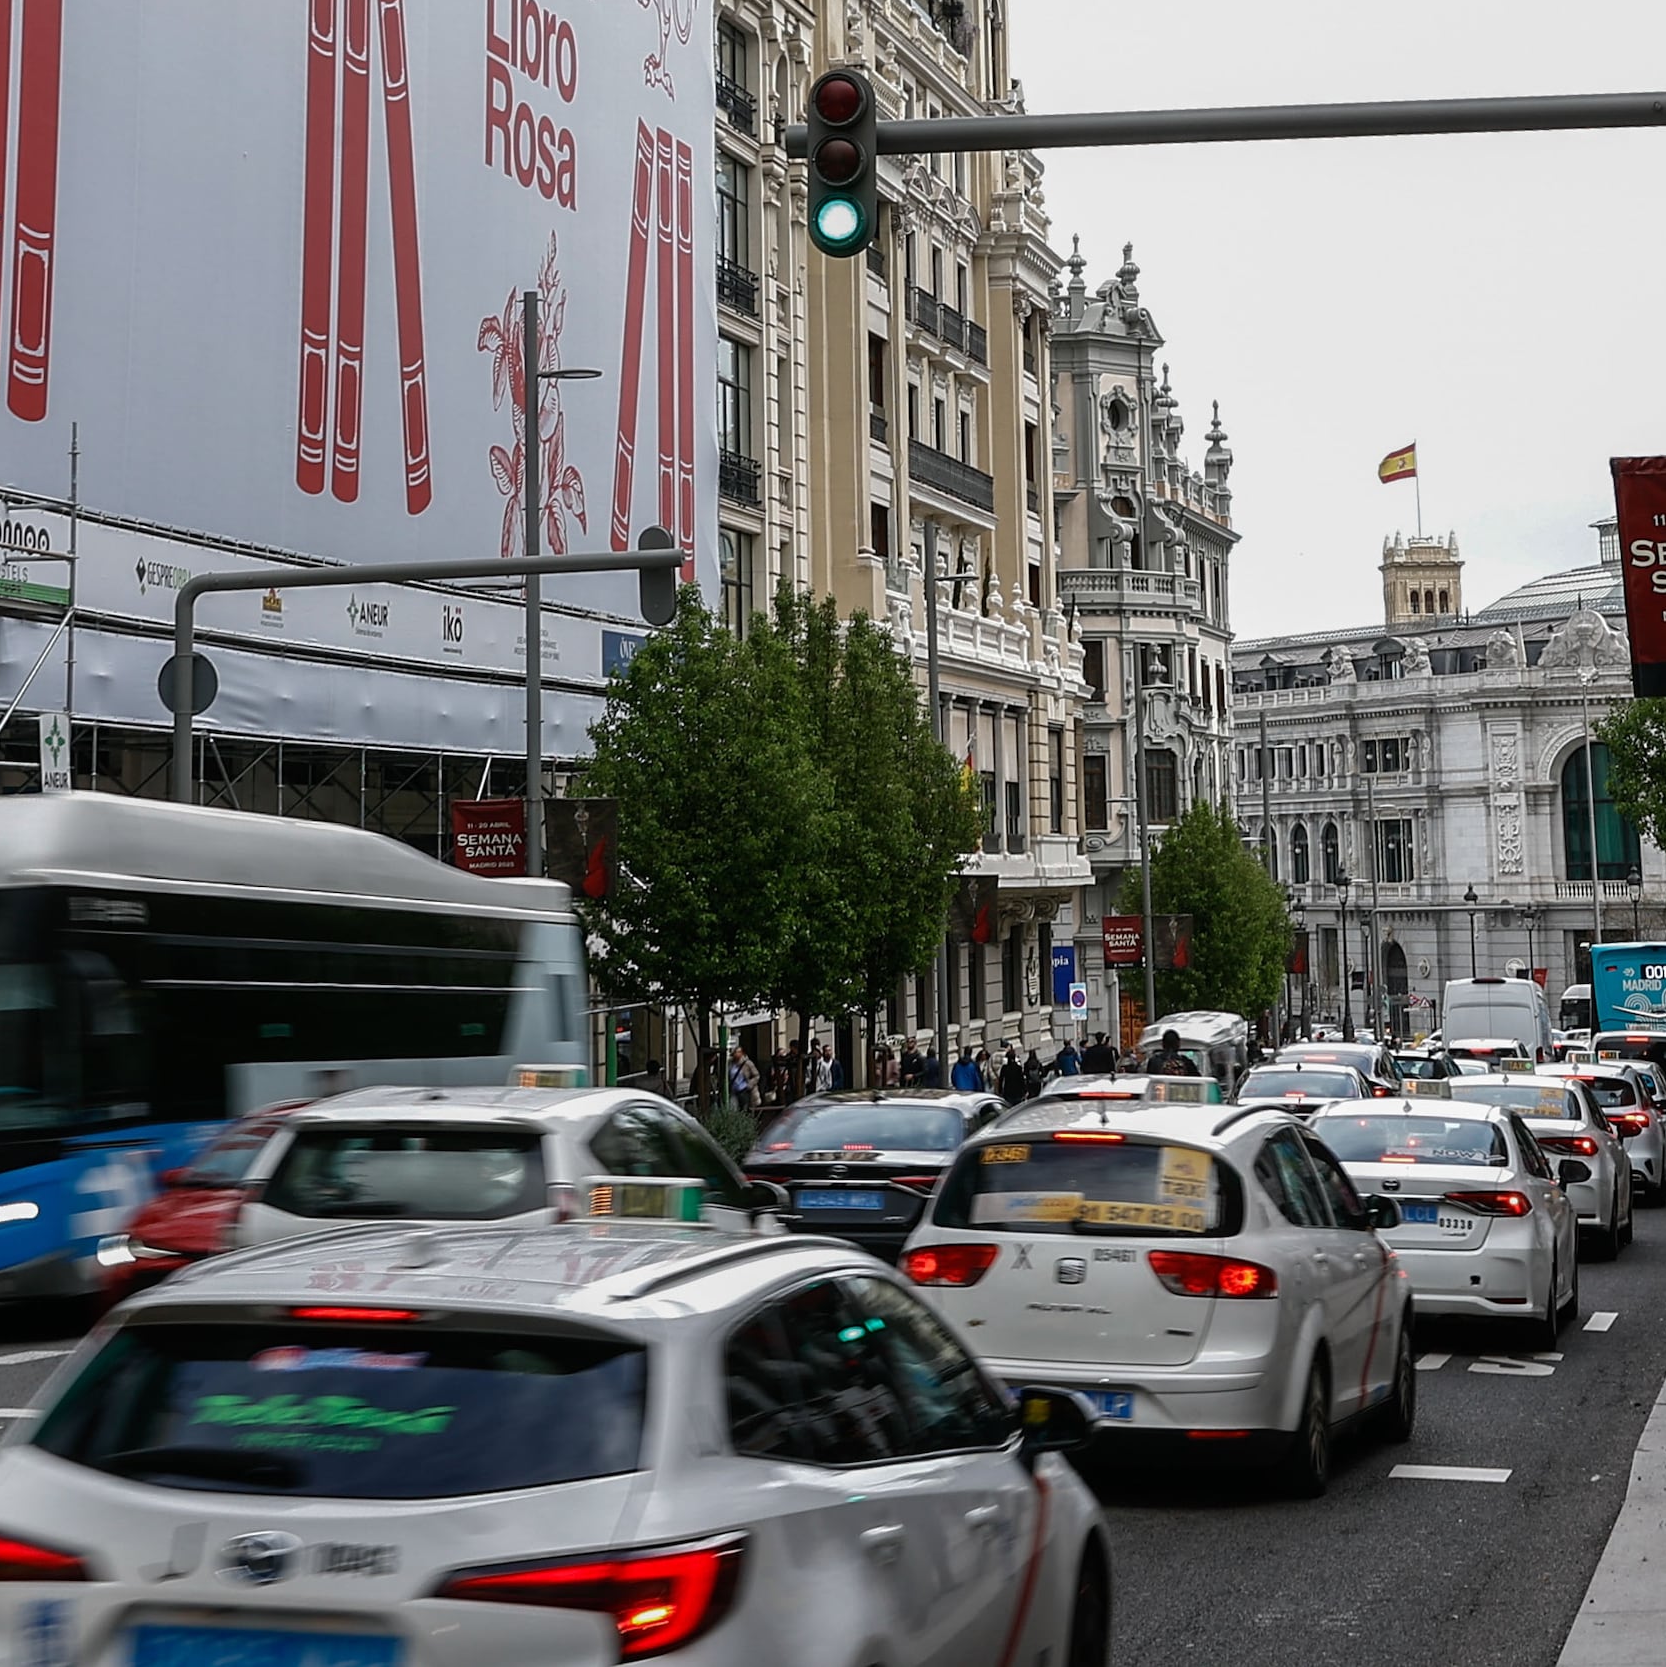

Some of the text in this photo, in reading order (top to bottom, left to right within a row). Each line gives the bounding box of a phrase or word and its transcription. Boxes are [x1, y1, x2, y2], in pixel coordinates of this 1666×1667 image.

[485, 55, 577, 211] Rosa
[1653, 514, 1666, 526] 11
[359, 601, 388, 627] ANEUR
[44, 771, 69, 789] ANEUR
[457, 833, 522, 846] SEMANA
[465, 844, 516, 857] SANTA
[1105, 933, 1140, 941] SEMANA
[1108, 939, 1137, 947] SANTA
[1623, 979, 1662, 991] MADRID
[1108, 1206, 1144, 1223] 547
